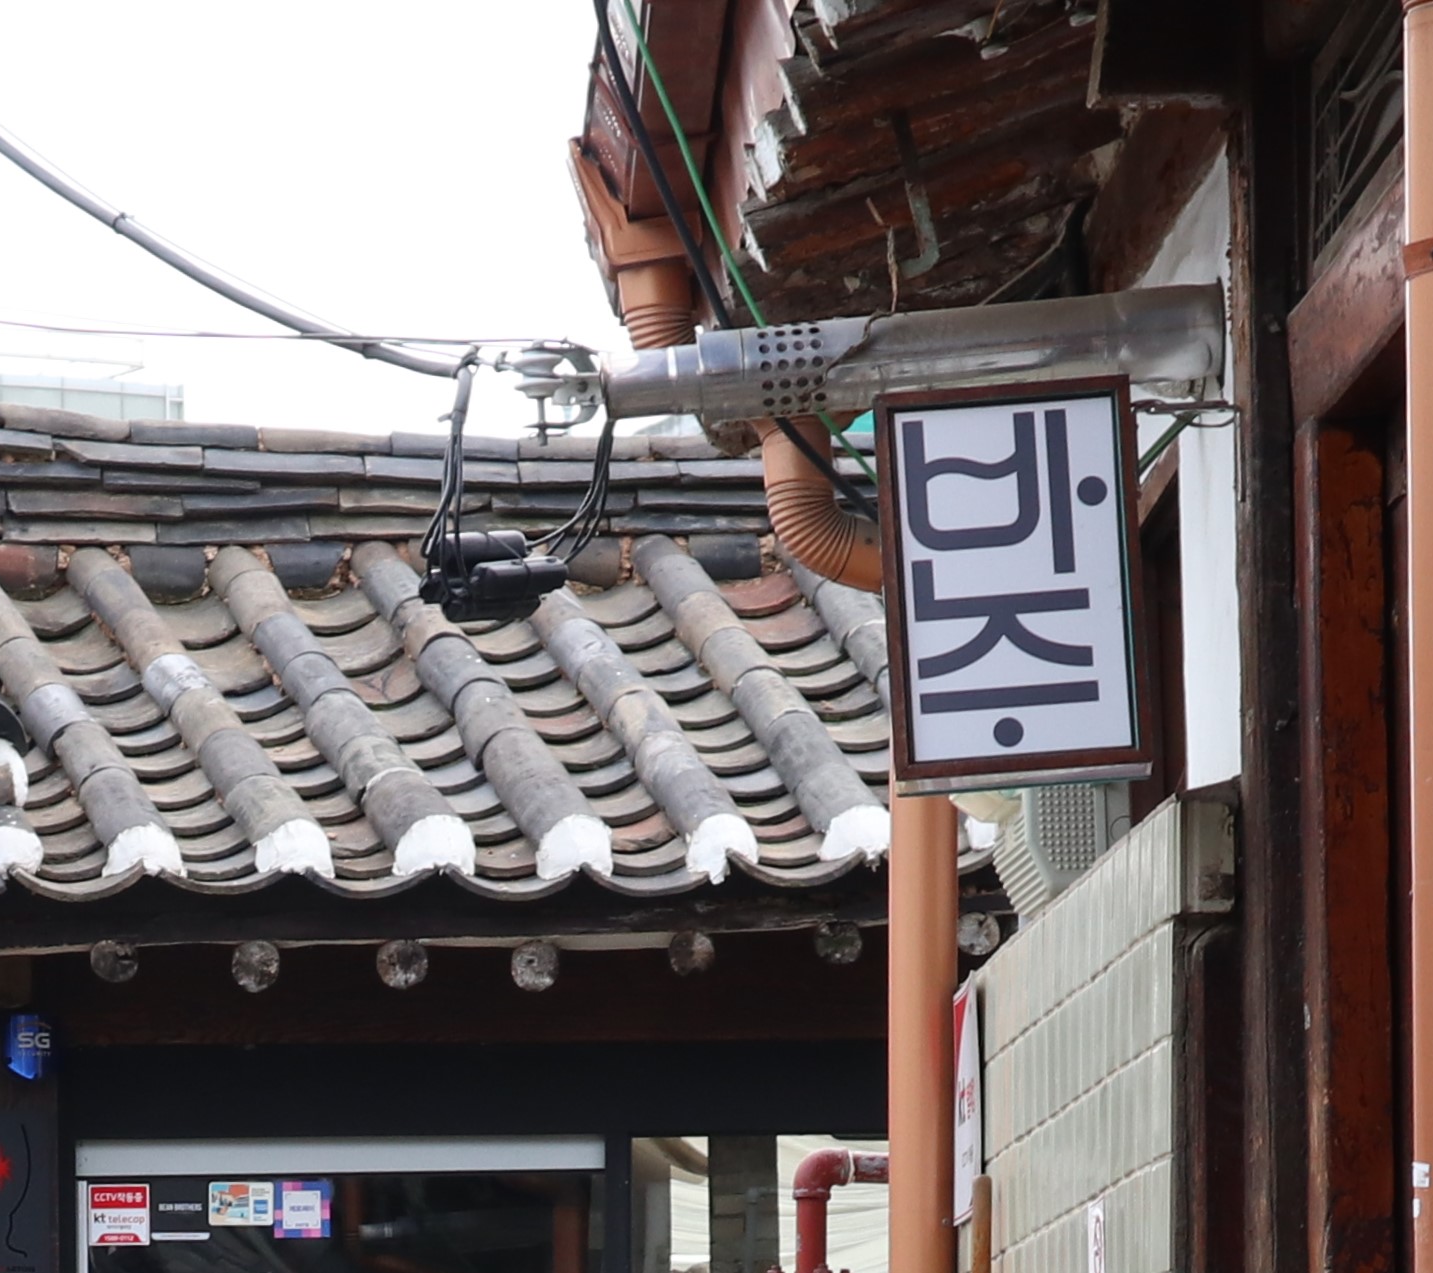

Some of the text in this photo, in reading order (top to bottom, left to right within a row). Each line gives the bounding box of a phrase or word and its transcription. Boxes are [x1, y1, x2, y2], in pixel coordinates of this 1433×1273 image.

[17, 1032, 51, 1049] SG
[158, 1203, 173, 1211] BEAN
[93, 1213, 145, 1225] kt telecop
